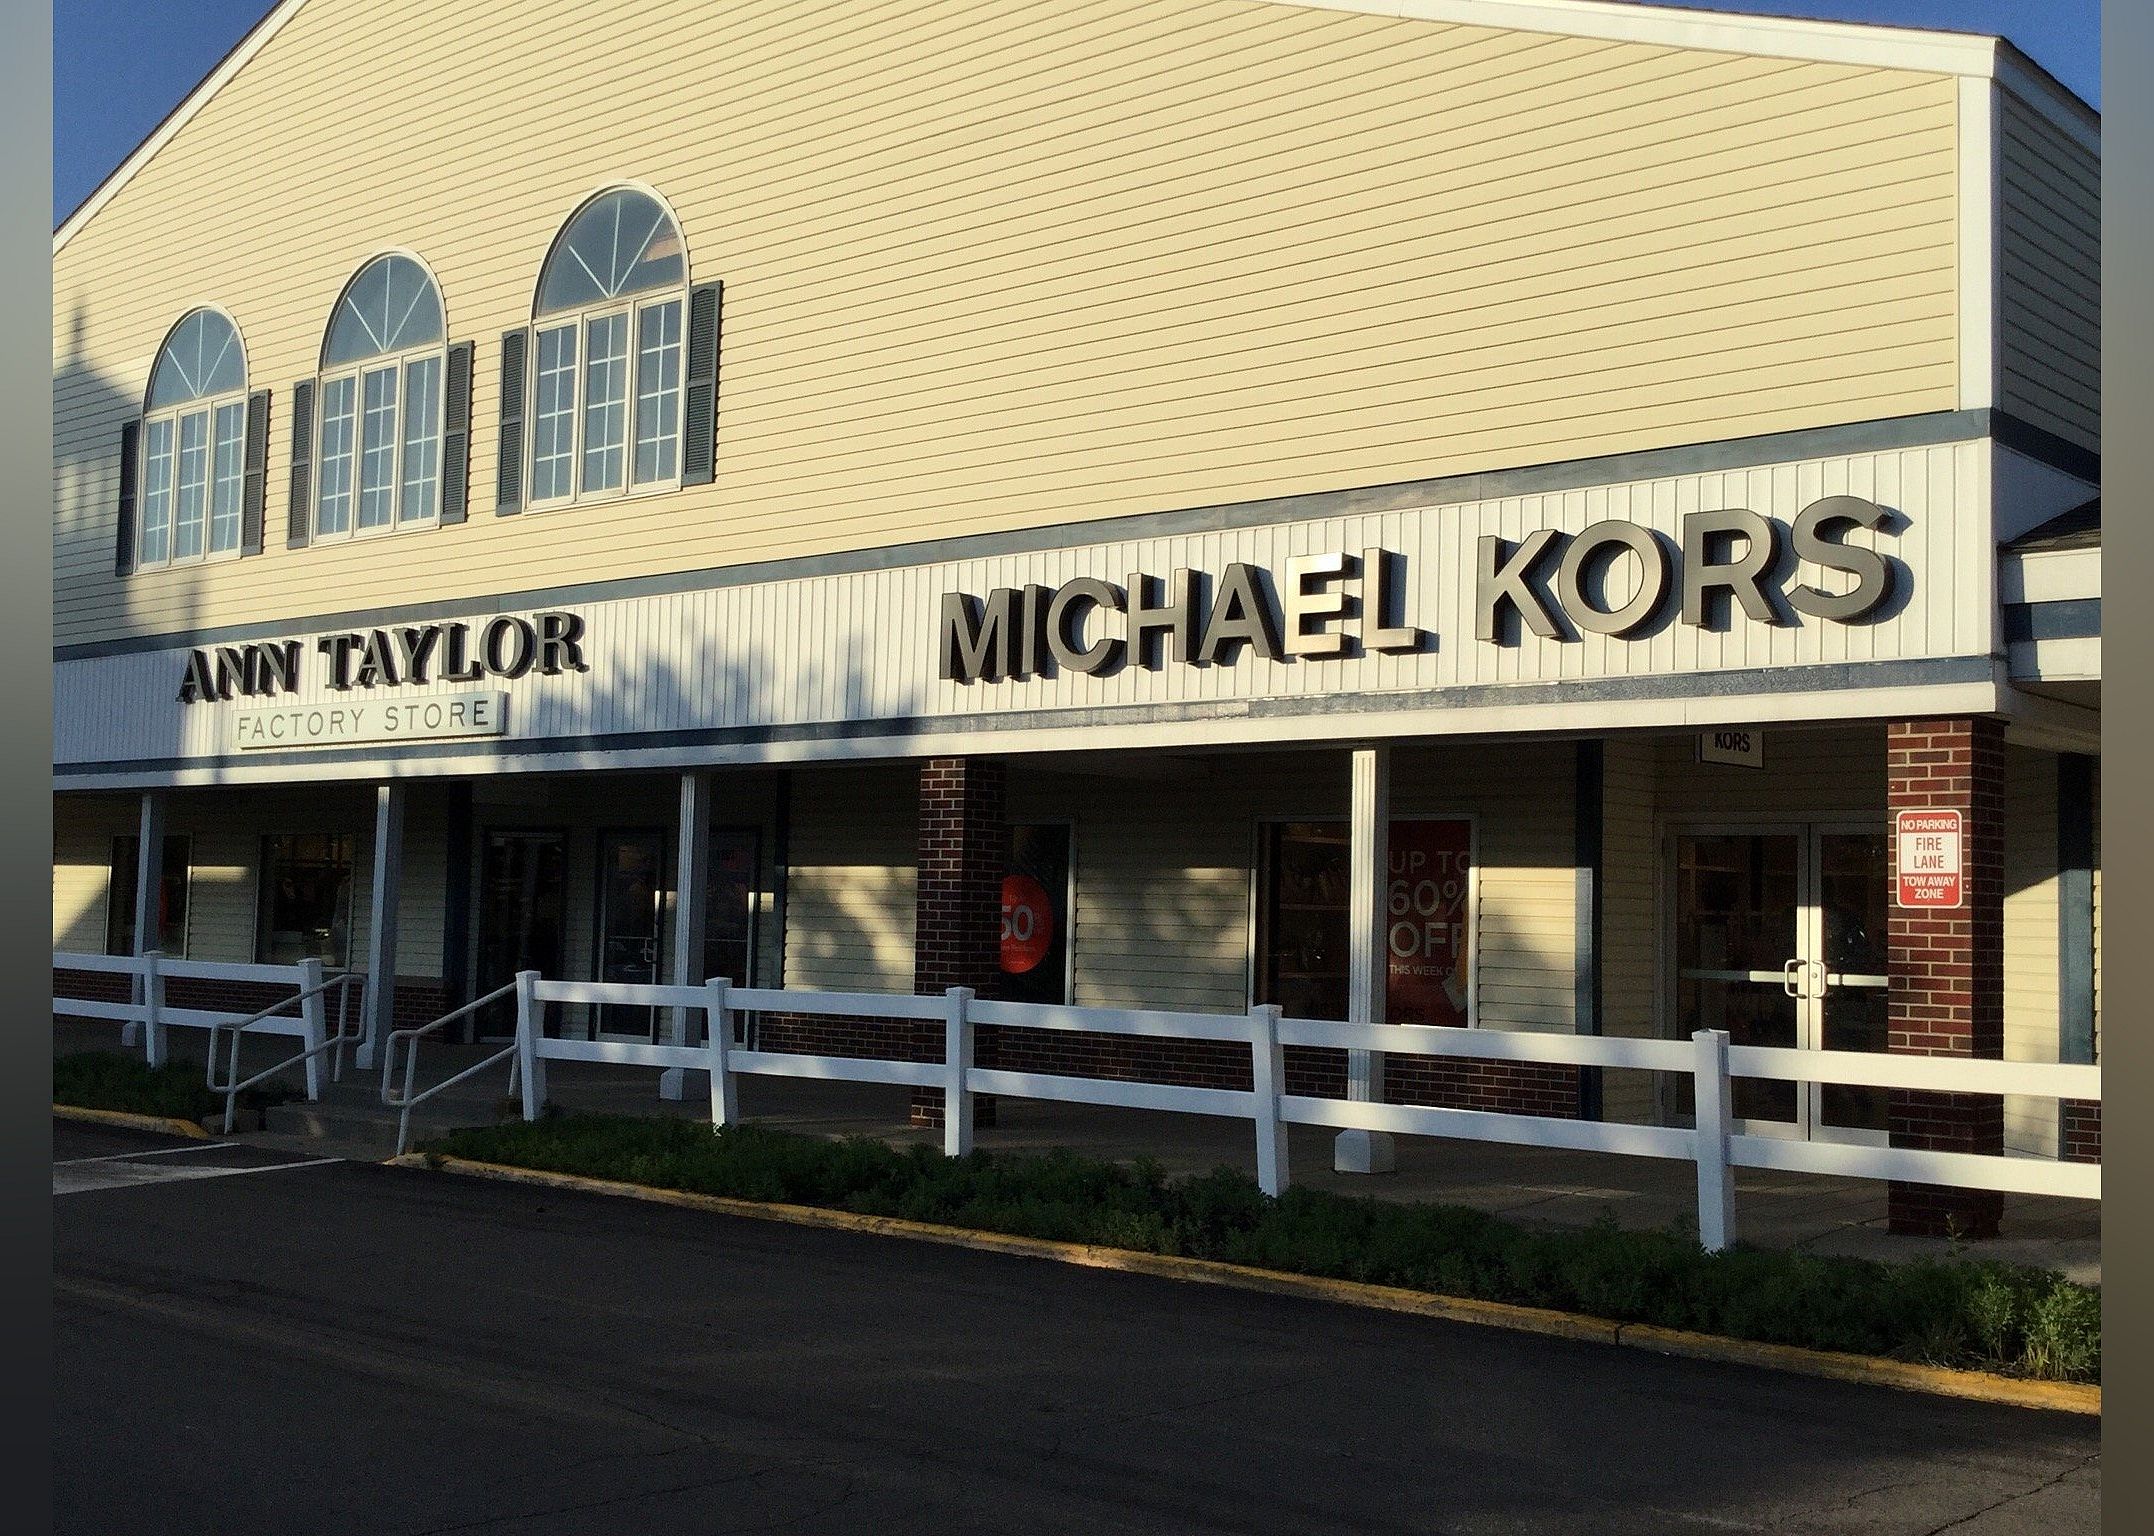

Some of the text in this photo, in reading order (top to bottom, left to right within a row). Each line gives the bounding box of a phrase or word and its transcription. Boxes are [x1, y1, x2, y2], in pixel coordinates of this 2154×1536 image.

[939, 495, 1896, 683] MICHAEL KORS
[178, 612, 590, 703] ANN TAYLOR
[238, 699, 489, 741] FACTORY STORE
[1714, 732, 1750, 752] KORS
[1901, 819, 1957, 830] NO PARKING
[1916, 837, 1942, 850] FIRE
[1389, 850, 1426, 874] UP
[1914, 855, 1944, 868] LANE
[1903, 876, 1956, 886] TOW AWAY
[1914, 888, 1944, 899] ZONE
[1389, 964, 1410, 975] THIS
[1412, 964, 1443, 976] WEEK
